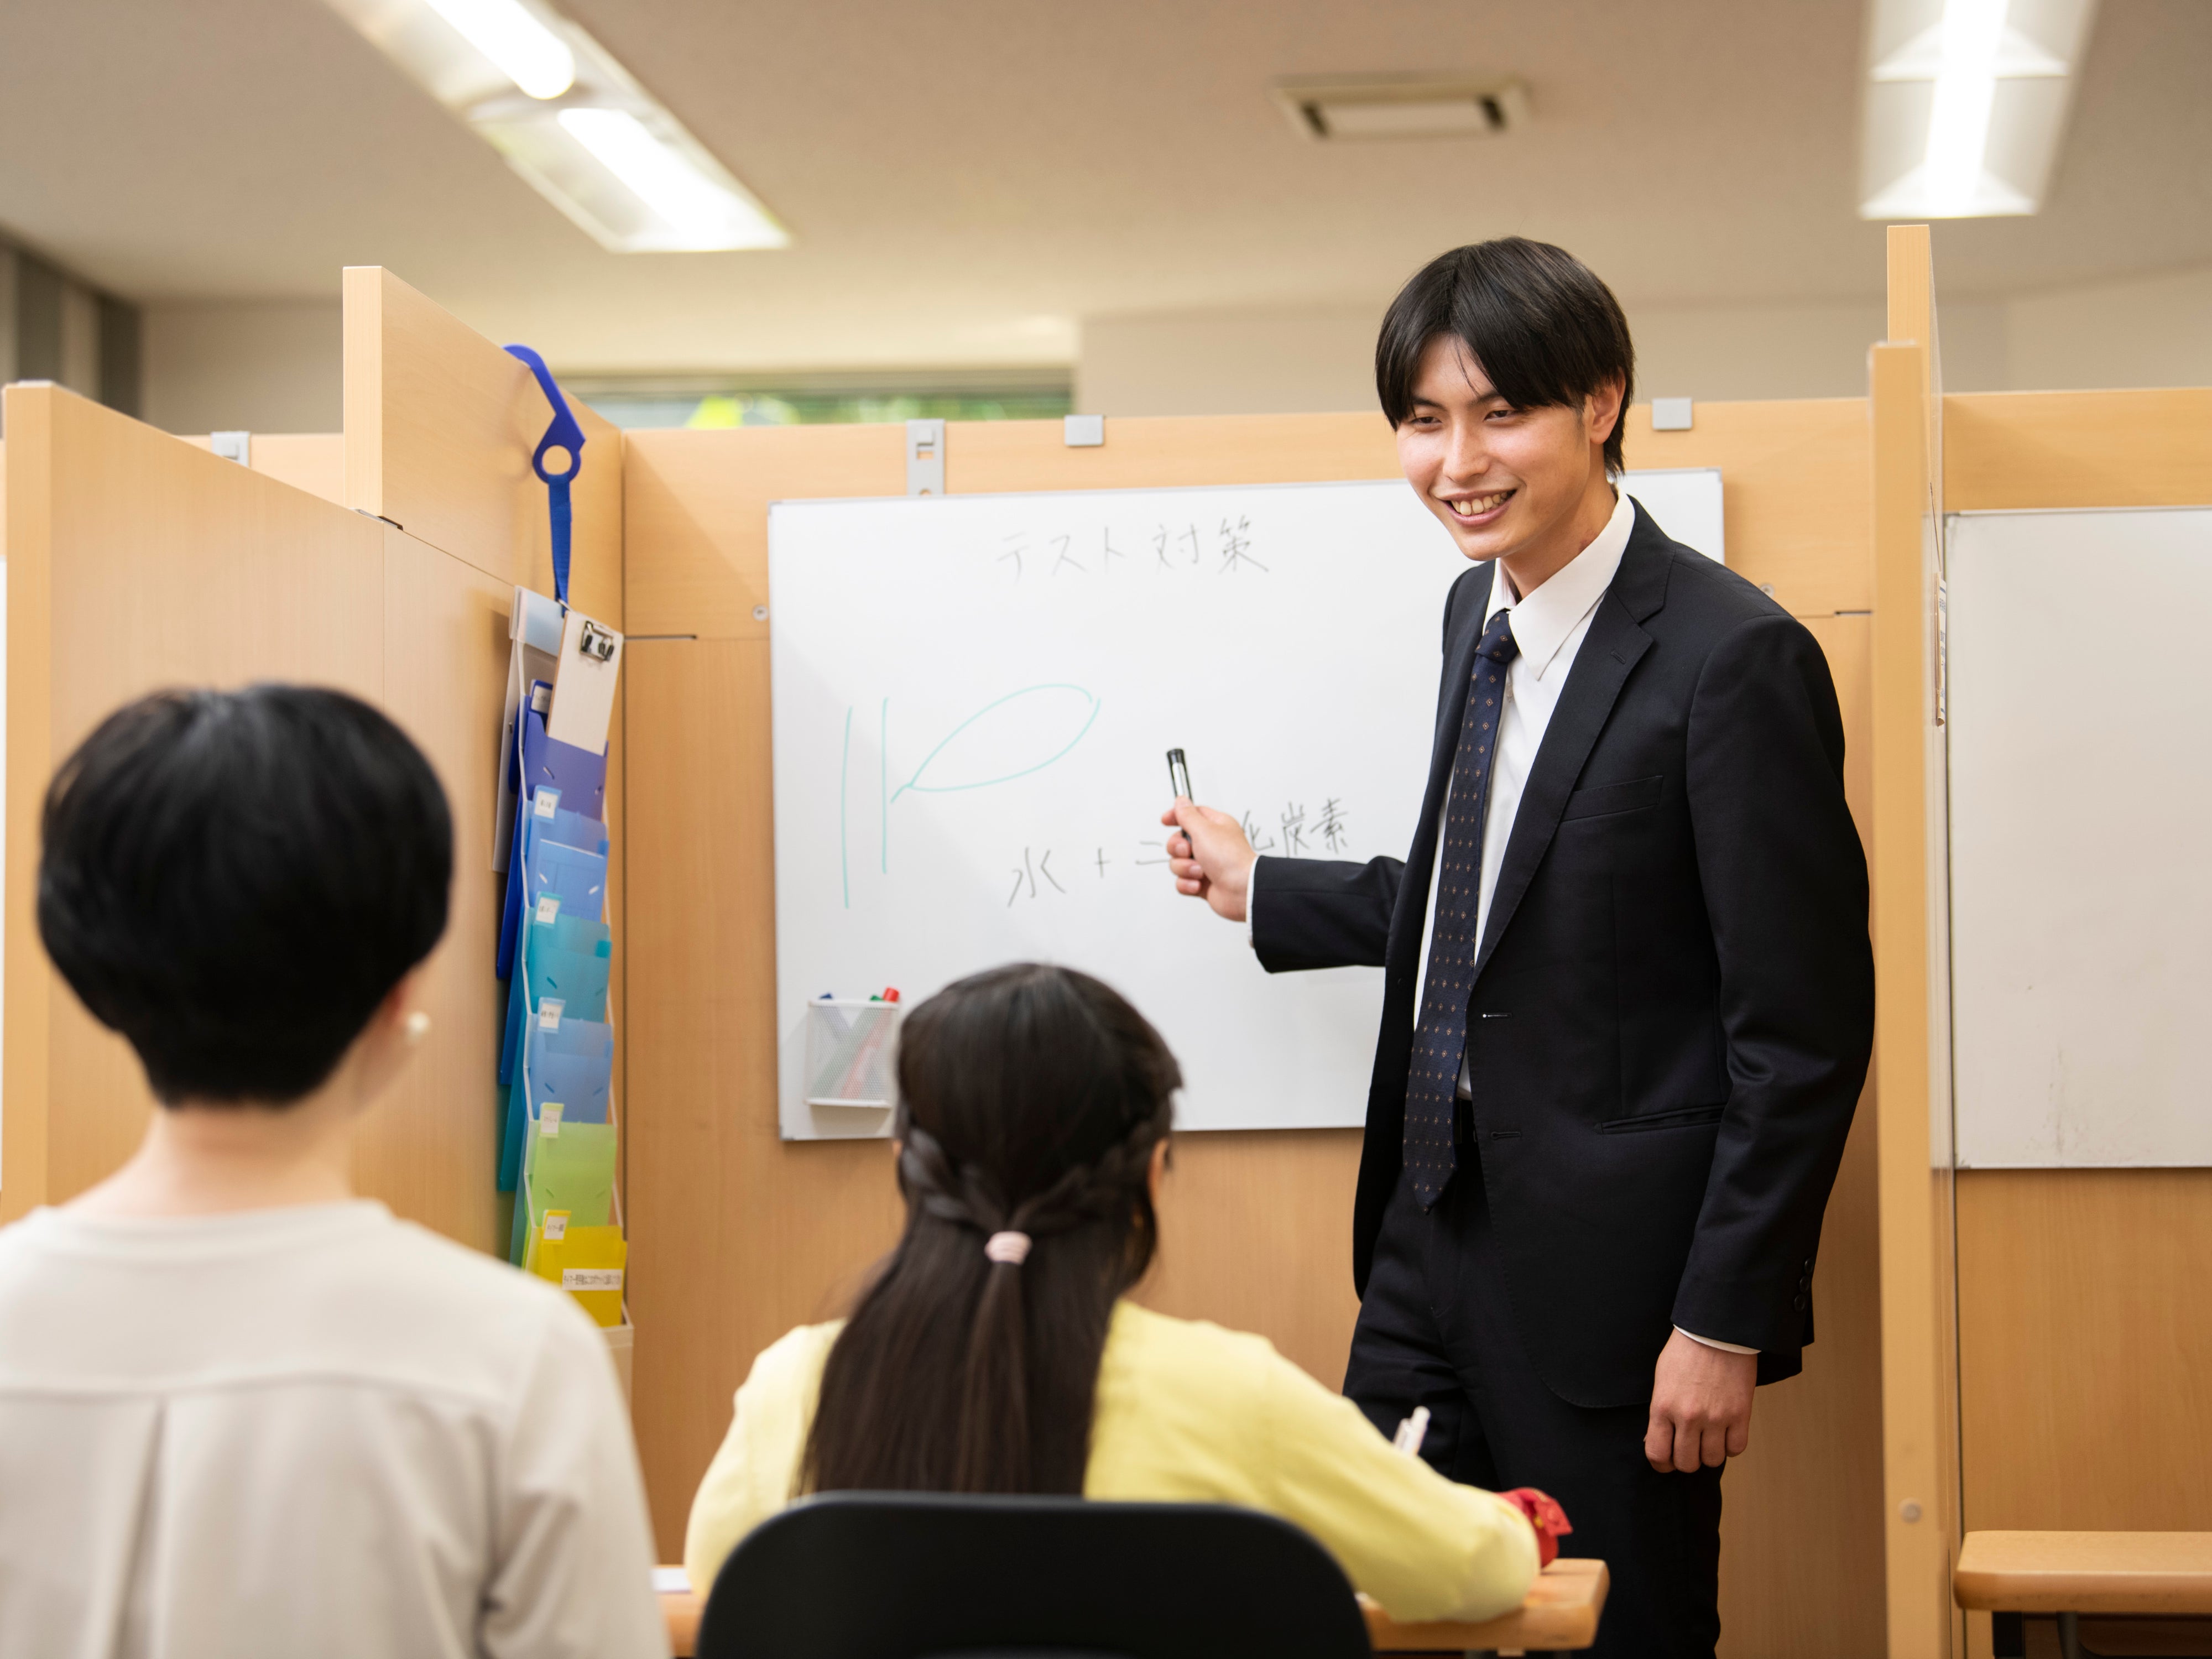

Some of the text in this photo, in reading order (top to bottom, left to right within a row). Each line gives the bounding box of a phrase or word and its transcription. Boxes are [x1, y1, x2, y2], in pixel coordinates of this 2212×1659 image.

[997, 514, 1270, 585] テスト対策
[1008, 846, 1066, 907] 水
